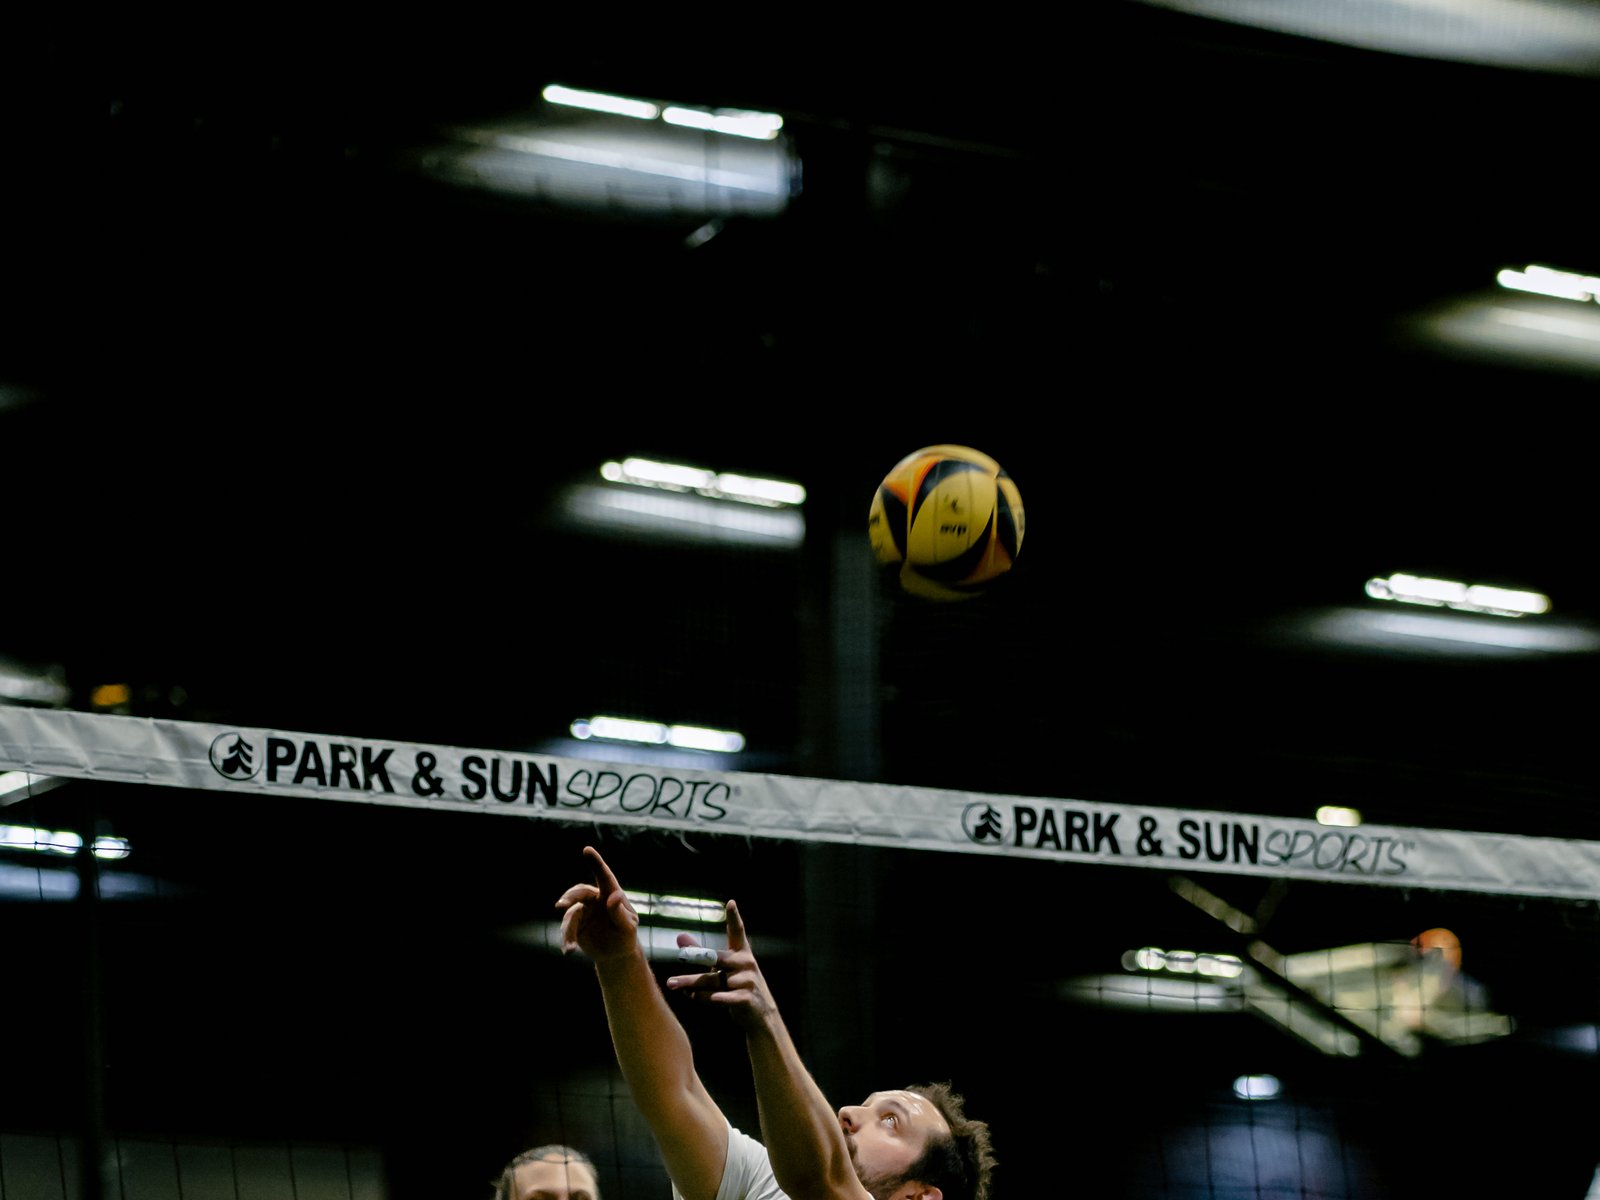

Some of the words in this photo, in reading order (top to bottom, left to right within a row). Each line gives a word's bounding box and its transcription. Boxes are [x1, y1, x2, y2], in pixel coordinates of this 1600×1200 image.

[266, 737, 396, 794] PARK
[411, 751, 445, 799] &
[460, 756, 558, 808] SUN
[558, 769, 731, 821] SPORTS
[1012, 806, 1121, 856] PARK
[1136, 817, 1164, 857] &
[1178, 819, 1260, 865] SUN
[1261, 829, 1407, 875] SPORTS
